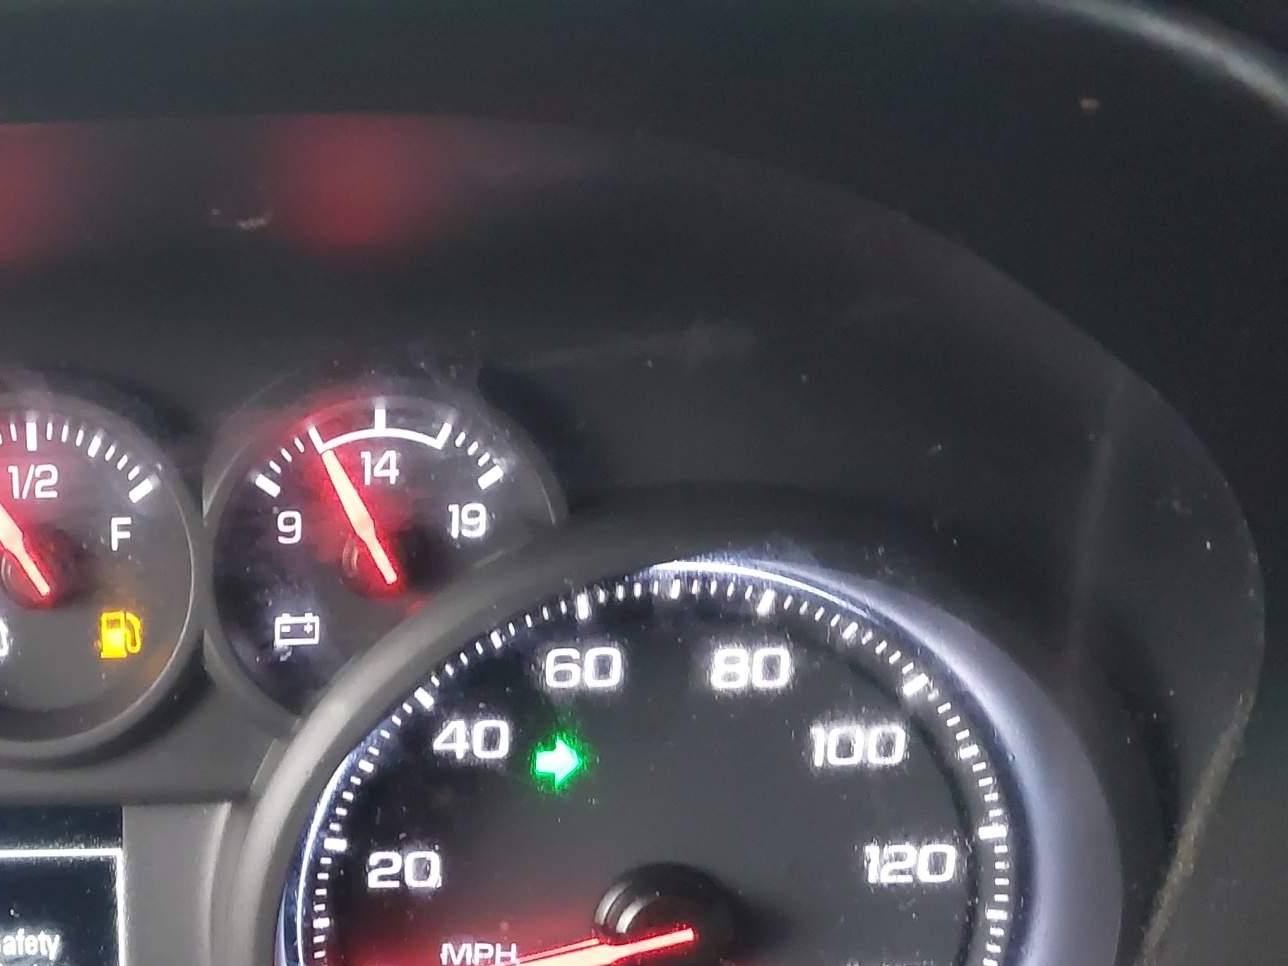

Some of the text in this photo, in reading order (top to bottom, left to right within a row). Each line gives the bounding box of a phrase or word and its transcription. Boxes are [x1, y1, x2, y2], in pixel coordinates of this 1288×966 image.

[8, 464, 58, 498] 1/2
[361, 451, 398, 485] 14
[111, 517, 132, 551] F
[277, 511, 302, 544] 9
[448, 503, 486, 537] 19
[544, 647, 622, 689] 60
[712, 647, 791, 690] 80
[432, 720, 510, 759] 40
[812, 725, 907, 768] 100
[367, 850, 442, 889] 20
[864, 843, 957, 884] 120
[440, 942, 518, 966] MPH
